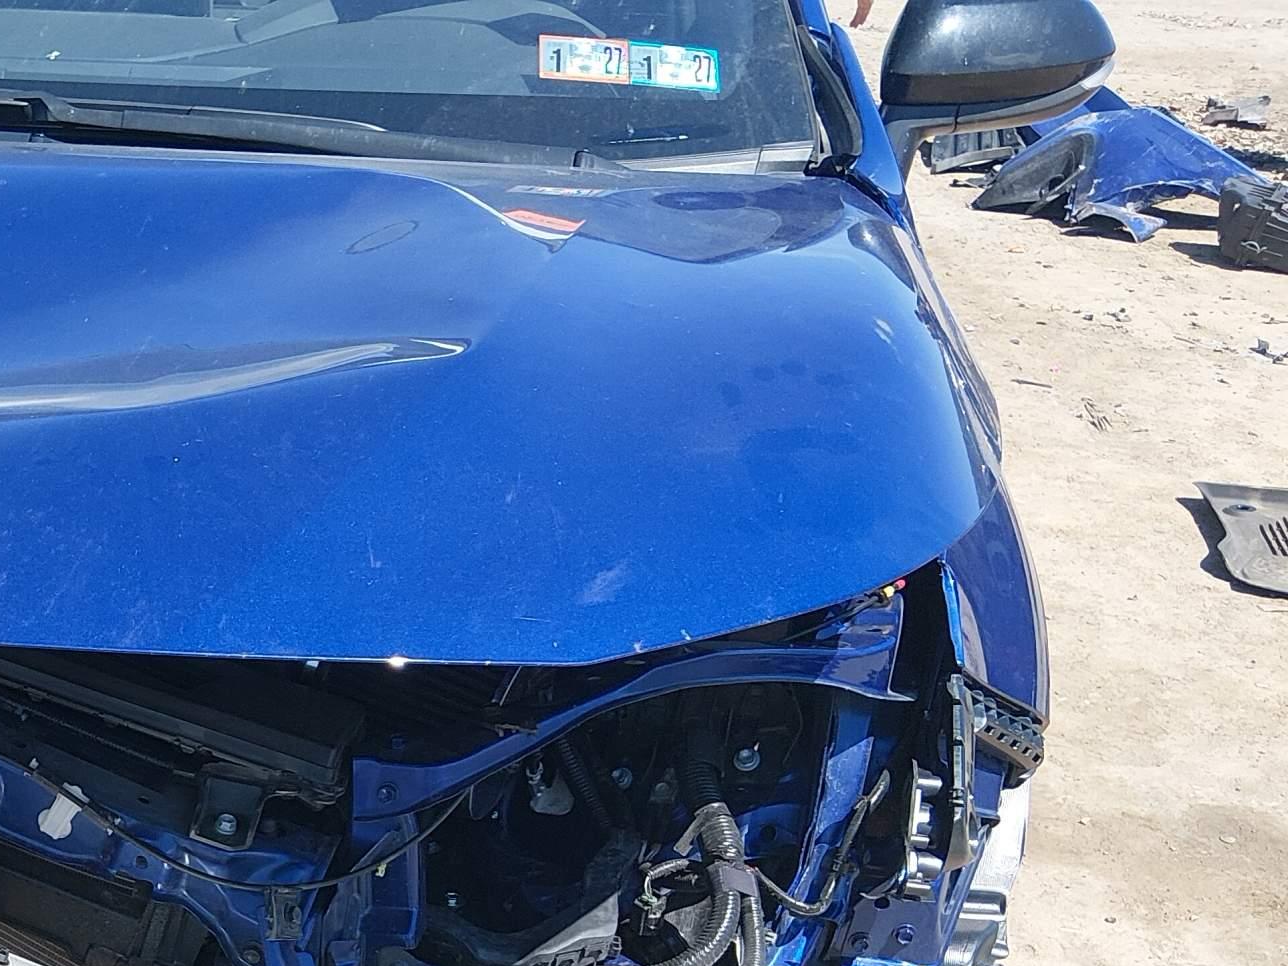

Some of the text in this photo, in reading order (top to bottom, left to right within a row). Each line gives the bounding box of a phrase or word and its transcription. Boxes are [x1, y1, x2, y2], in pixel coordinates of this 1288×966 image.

[552, 48, 561, 73] 1
[603, 46, 623, 75] 27
[642, 55, 652, 80] 1
[693, 54, 712, 83] 27
